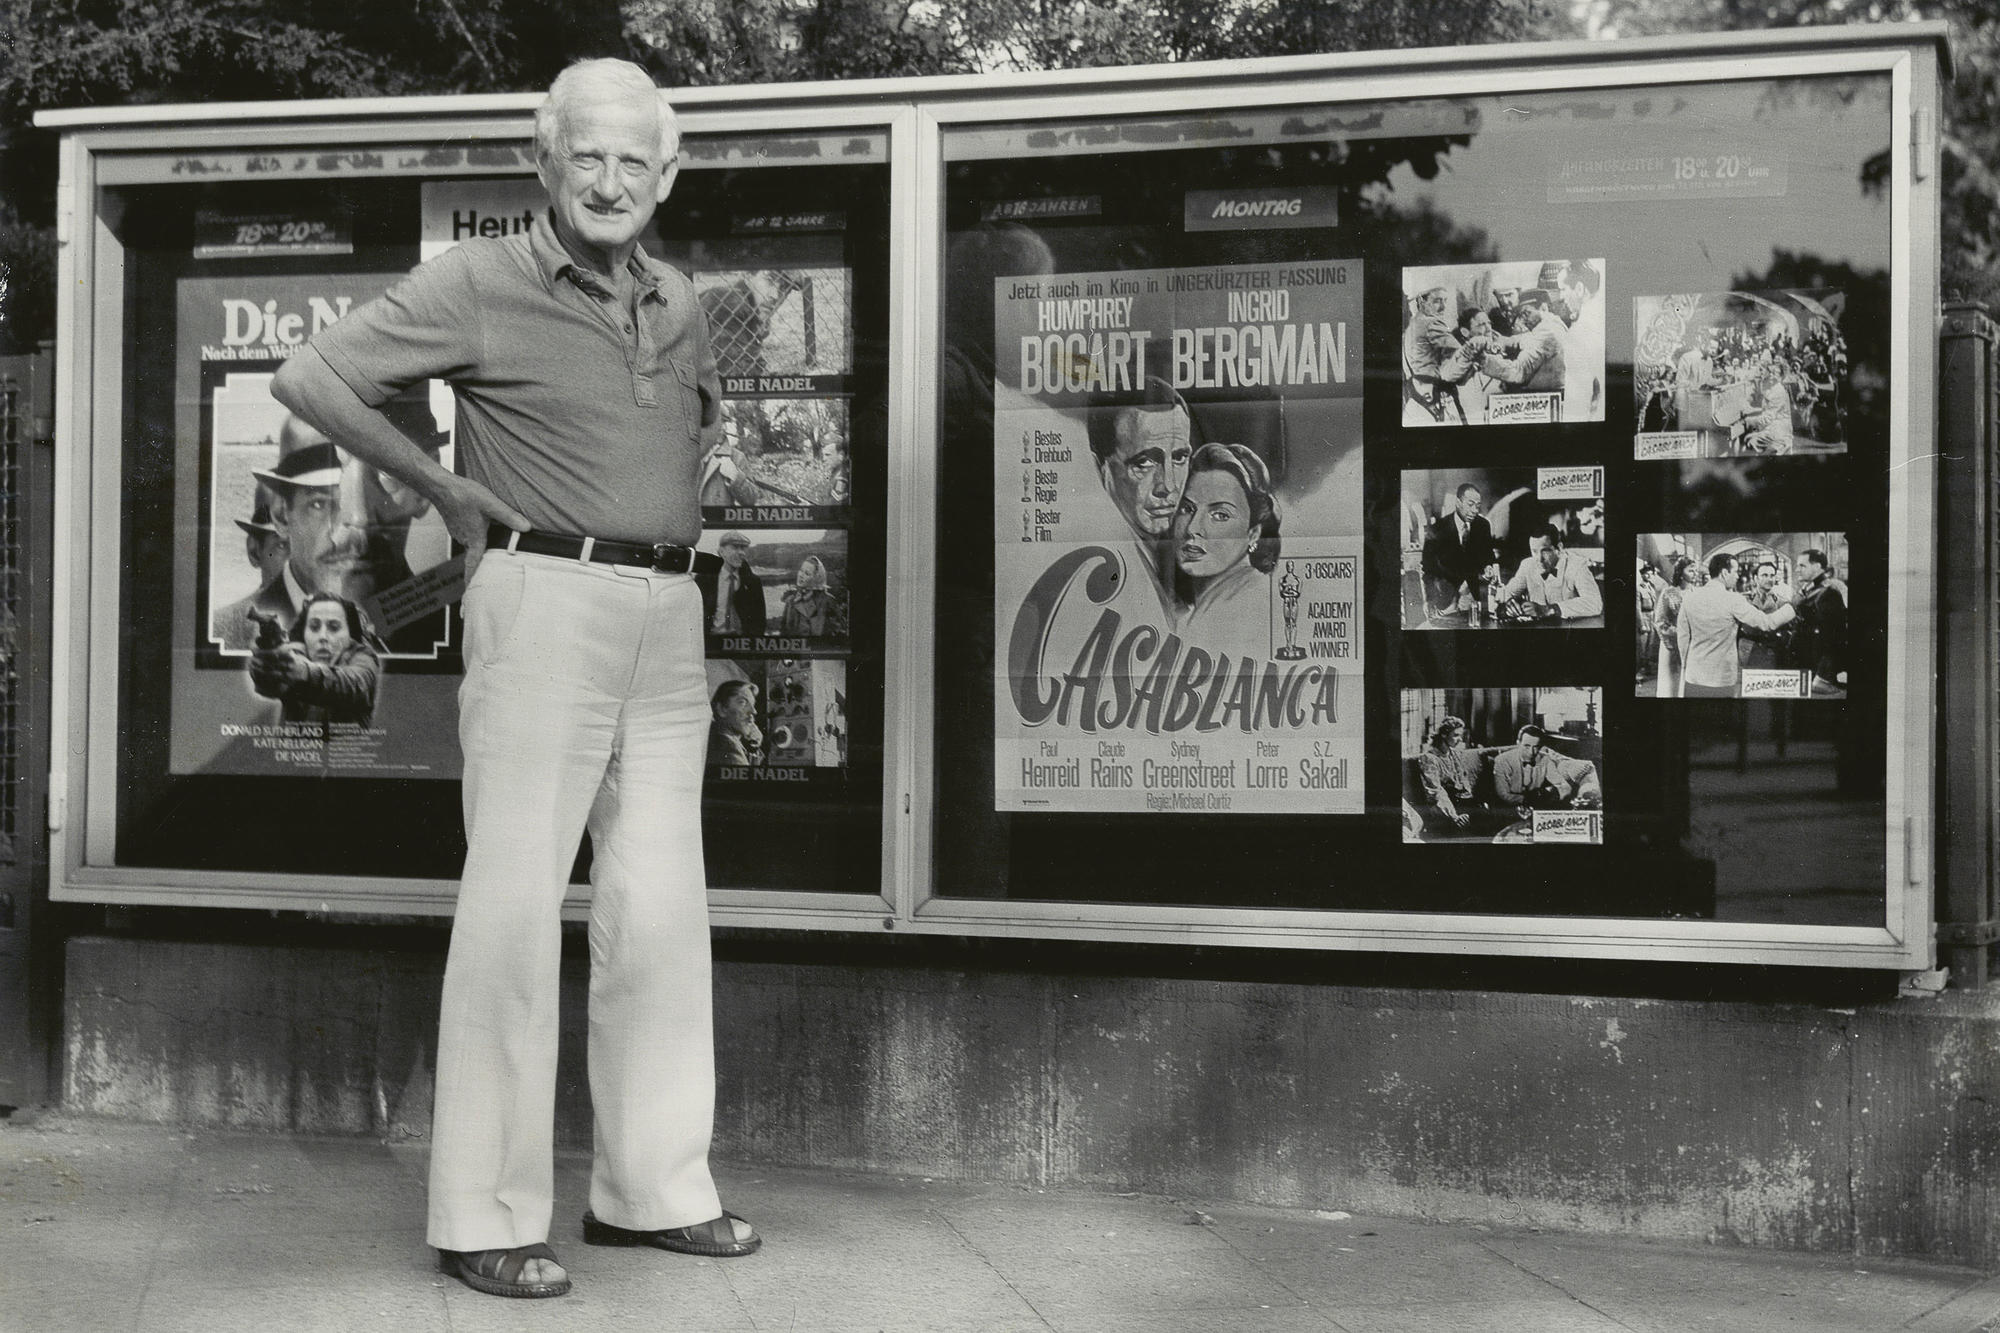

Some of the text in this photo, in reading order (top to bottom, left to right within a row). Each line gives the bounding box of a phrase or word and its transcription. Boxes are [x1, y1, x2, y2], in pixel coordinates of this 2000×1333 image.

[1030, 200, 1088, 212] JAHREN
[1212, 199, 1302, 219] MONTAG
[453, 209, 535, 241] Heut
[1008, 266, 1346, 300] Jetzt auch im Kino in UNGEKÜRZTER FASSUNG
[1228, 289, 1290, 323] INGRID
[222, 297, 352, 346] Die N
[1038, 297, 1133, 332] HUMPHREY
[201, 345, 237, 361] Nach
[239, 345, 269, 360] dem
[1021, 322, 1346, 395] BOGART BERGMAN
[726, 377, 815, 392] DIE NADEL
[1035, 430, 1062, 446] Bestes
[1035, 447, 1072, 463] Drehbuch
[1035, 469, 1058, 485] Beste
[1035, 486, 1057, 505] Regie
[724, 507, 814, 521] DIE NADEL
[1035, 509, 1061, 524] Bester
[1035, 525, 1052, 542] Film
[1307, 602, 1352, 618] ACADEMY
[1312, 622, 1346, 638] AWARD
[722, 637, 811, 651] DIE NADEL
[1007, 545, 1338, 736] CASABLANCA
[1309, 641, 1349, 658] WINNER
[221, 724, 261, 736] DONALD
[263, 726, 323, 737] SUTHERLAND
[253, 738, 277, 749] KATE
[279, 739, 323, 750] NELLIGAN
[1040, 741, 1058, 757] Paul
[1098, 740, 1125, 757] Claude
[1171, 740, 1200, 761] Sydney
[1256, 740, 1279, 757] Peter
[275, 750, 289, 761] DIE
[291, 751, 322, 762] NADEL
[720, 768, 809, 781] DIE NADEL
[1022, 758, 1348, 789] Henreid Rains Greenstreet Lorre Sakall
